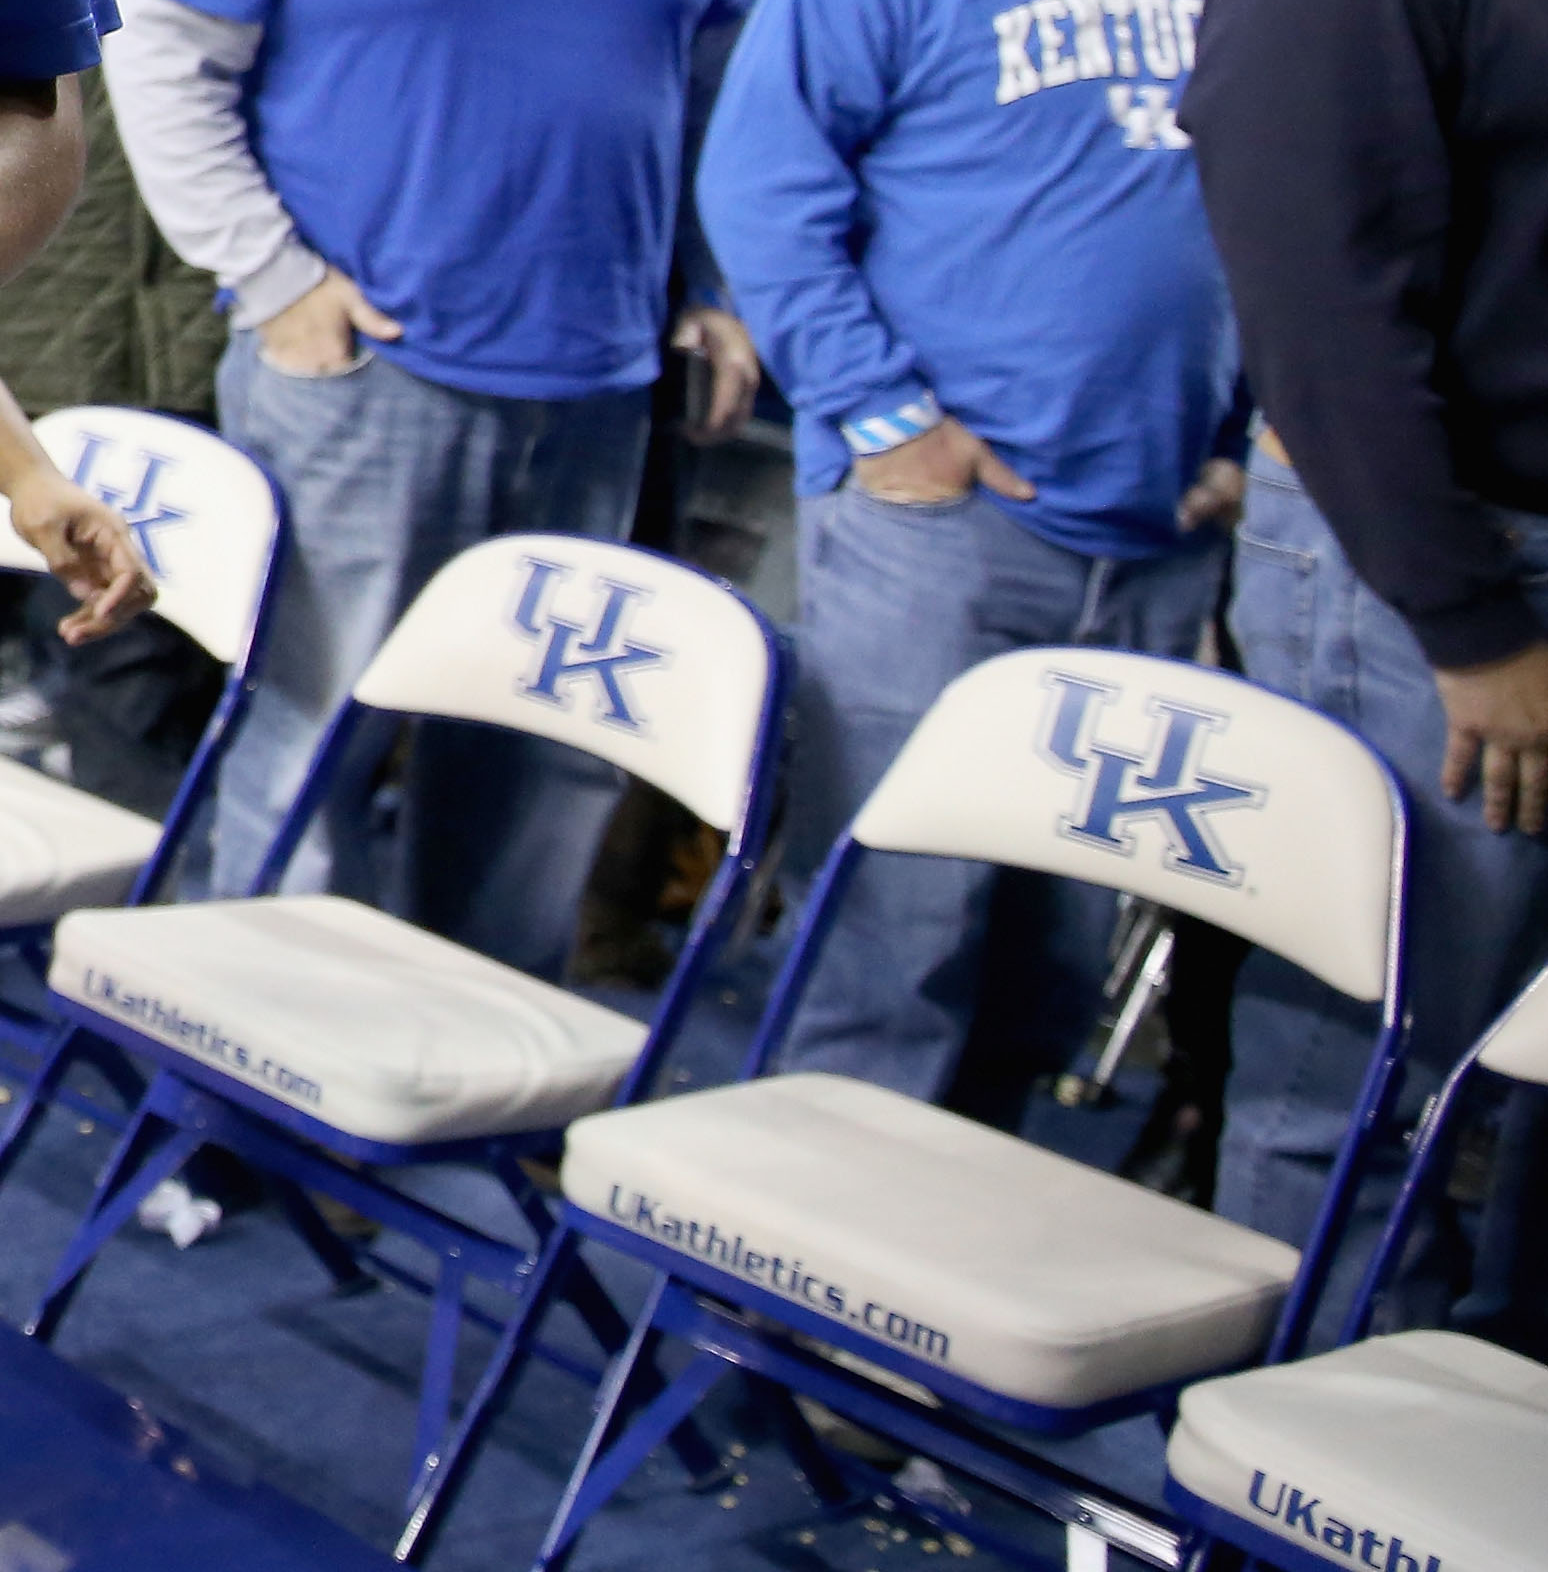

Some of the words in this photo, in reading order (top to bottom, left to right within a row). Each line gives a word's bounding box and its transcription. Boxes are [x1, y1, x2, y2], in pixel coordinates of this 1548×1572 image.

[1107, 83, 1193, 151] UK
[506, 554, 672, 738] UK
[1034, 669, 1267, 889] UK
[81, 966, 325, 1108] UKathletics.com
[608, 1182, 951, 1364] UKathletics.com
